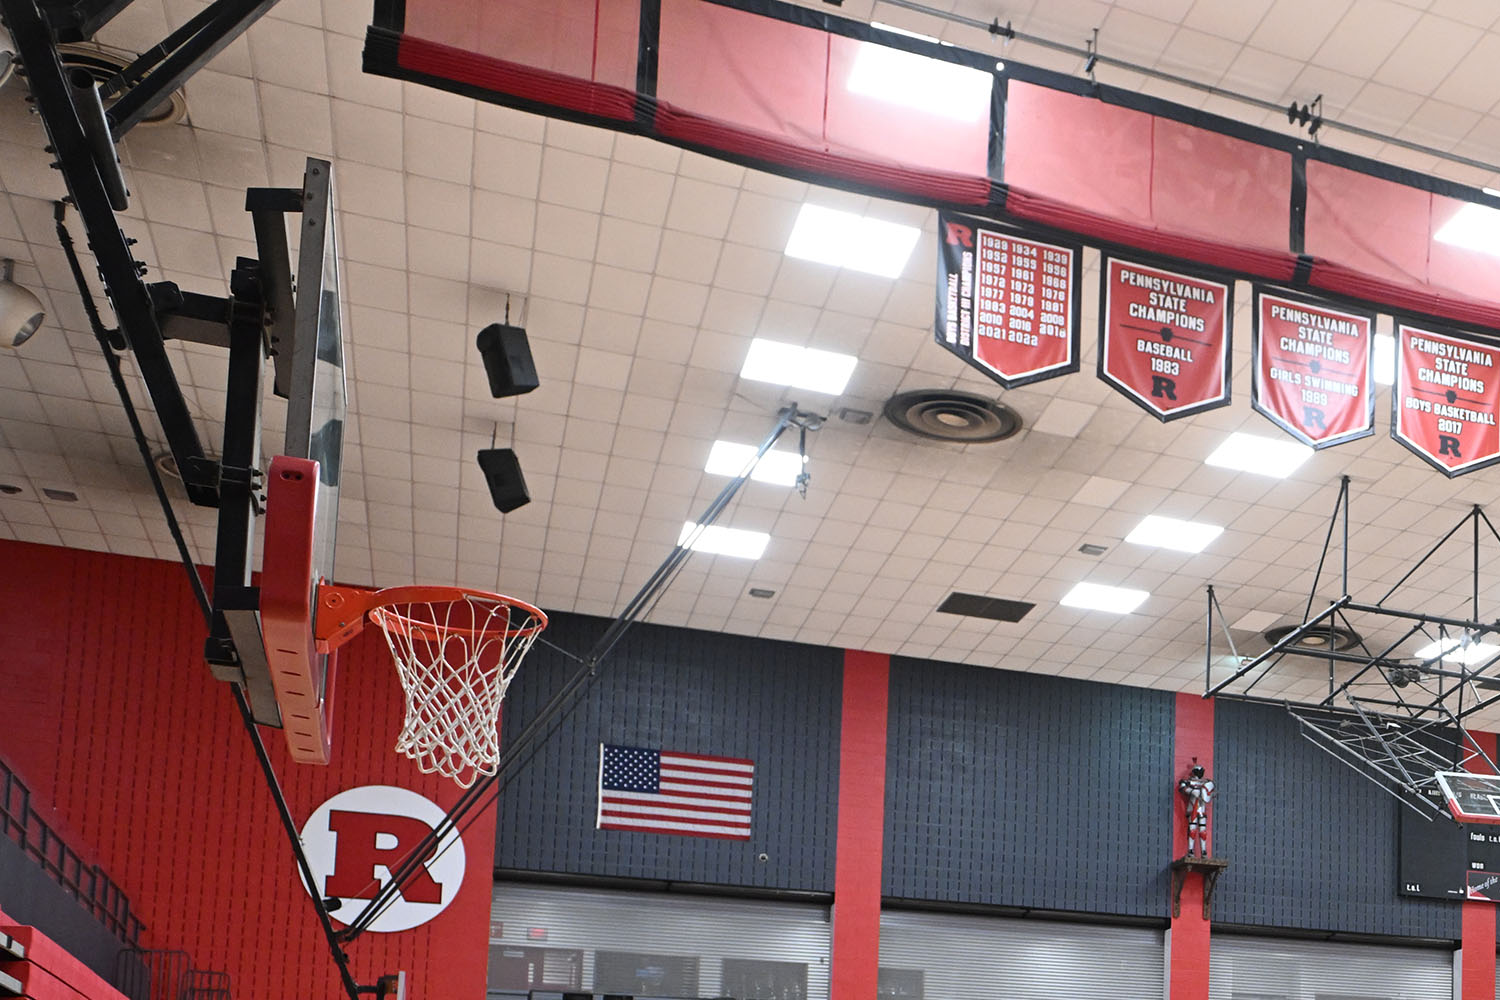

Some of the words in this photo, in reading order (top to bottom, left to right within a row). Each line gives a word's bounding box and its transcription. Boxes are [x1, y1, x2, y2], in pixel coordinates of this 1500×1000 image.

[946, 222, 973, 247] R
[1011, 243, 1038, 257] 1934
[981, 261, 1007, 275] 1957
[981, 274, 1006, 288] 1972
[1120, 270, 1215, 304] PENNSYLVANIA
[980, 286, 1005, 300] 1977
[1149, 292, 1187, 312] STATE
[1129, 303, 1205, 332] CHAMPIONS
[1271, 305, 1359, 337] PENNSYLVANIA
[978, 325, 1006, 340] 2021
[1298, 327, 1333, 345] STATE
[1136, 339, 1194, 362] BASEBALL
[1280, 337, 1350, 365] CHAMPIONS
[1410, 336, 1493, 367] PENNSYLVANIA
[1151, 358, 1180, 376] 1983
[1435, 358, 1468, 376] STATE
[1152, 376, 1177, 400] R
[1270, 368, 1301, 385] GIRLS
[1305, 374, 1359, 397] SWIMMING
[1418, 368, 1485, 394] CHAMPIONS
[1303, 406, 1327, 430] R
[1405, 396, 1432, 413] BOYS
[1433, 402, 1496, 425] BASKETBALL
[1438, 418, 1463, 435] 2017
[1438, 435, 1462, 458] R
[324, 810, 442, 904] R
